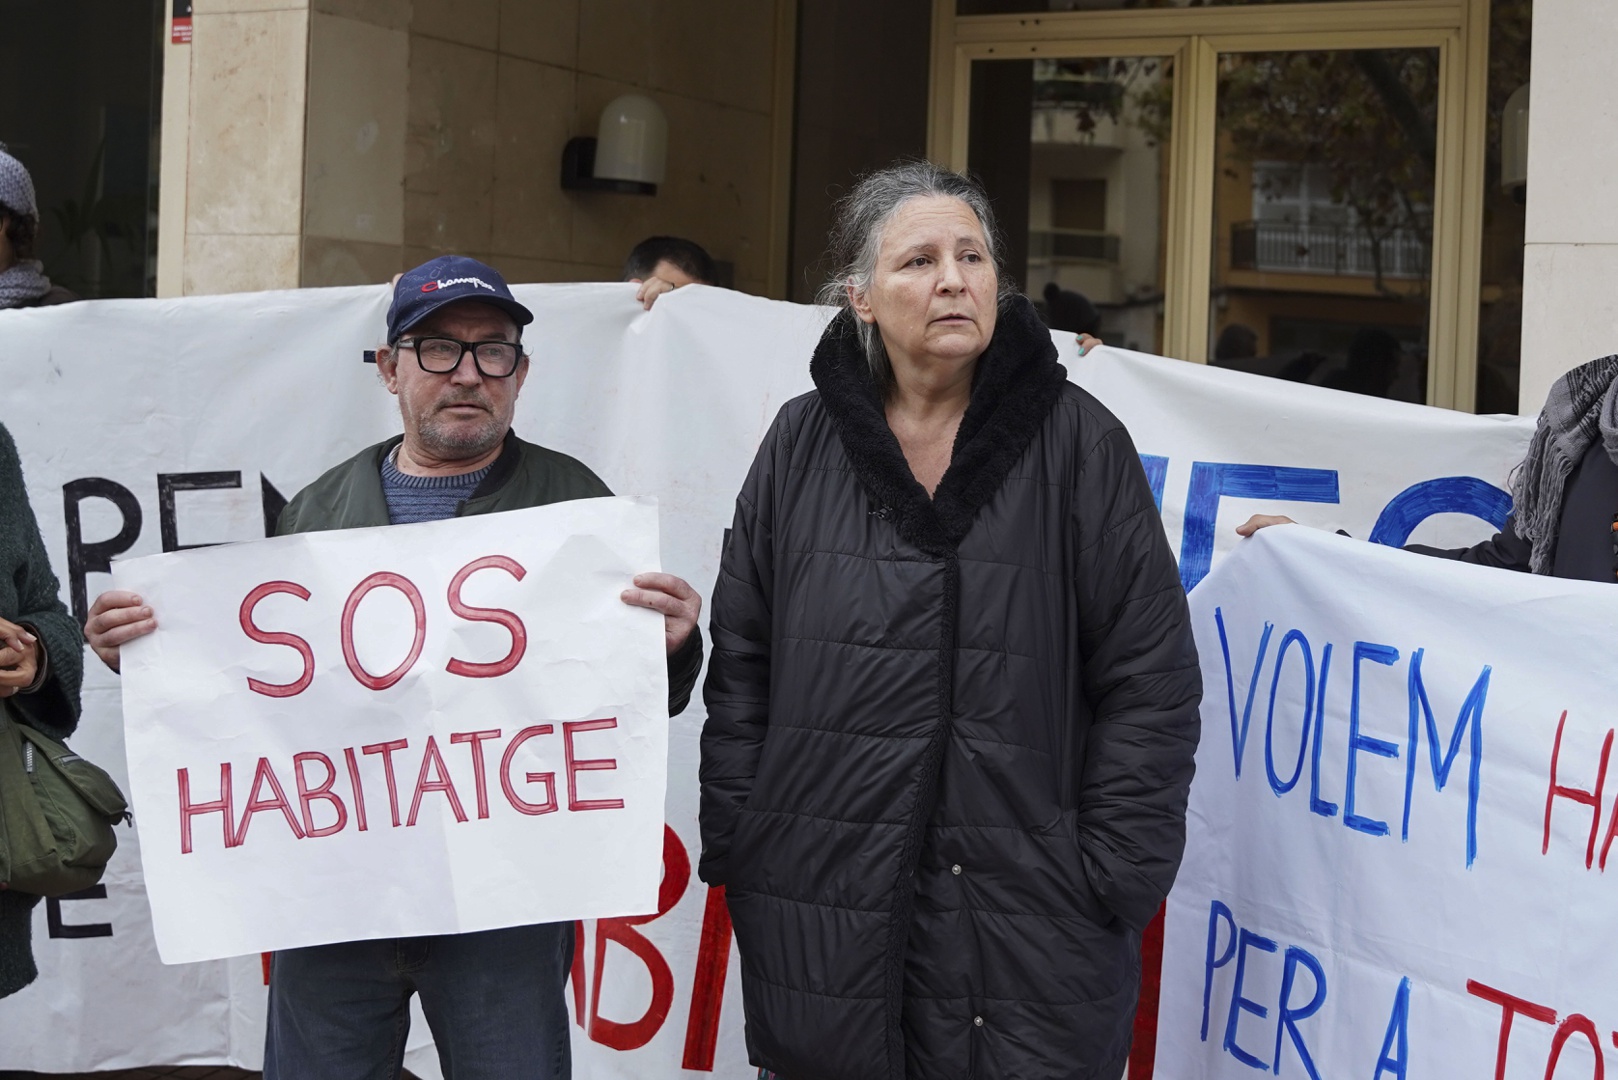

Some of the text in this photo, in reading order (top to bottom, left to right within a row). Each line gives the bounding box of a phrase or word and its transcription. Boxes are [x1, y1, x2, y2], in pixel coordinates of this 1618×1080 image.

[239, 555, 528, 698] SOS
[177, 717, 625, 854] HABITATGE
[1215, 606, 1492, 871] VOLEM
[1201, 900, 1327, 1080] PER
[1372, 975, 1412, 1080] A
